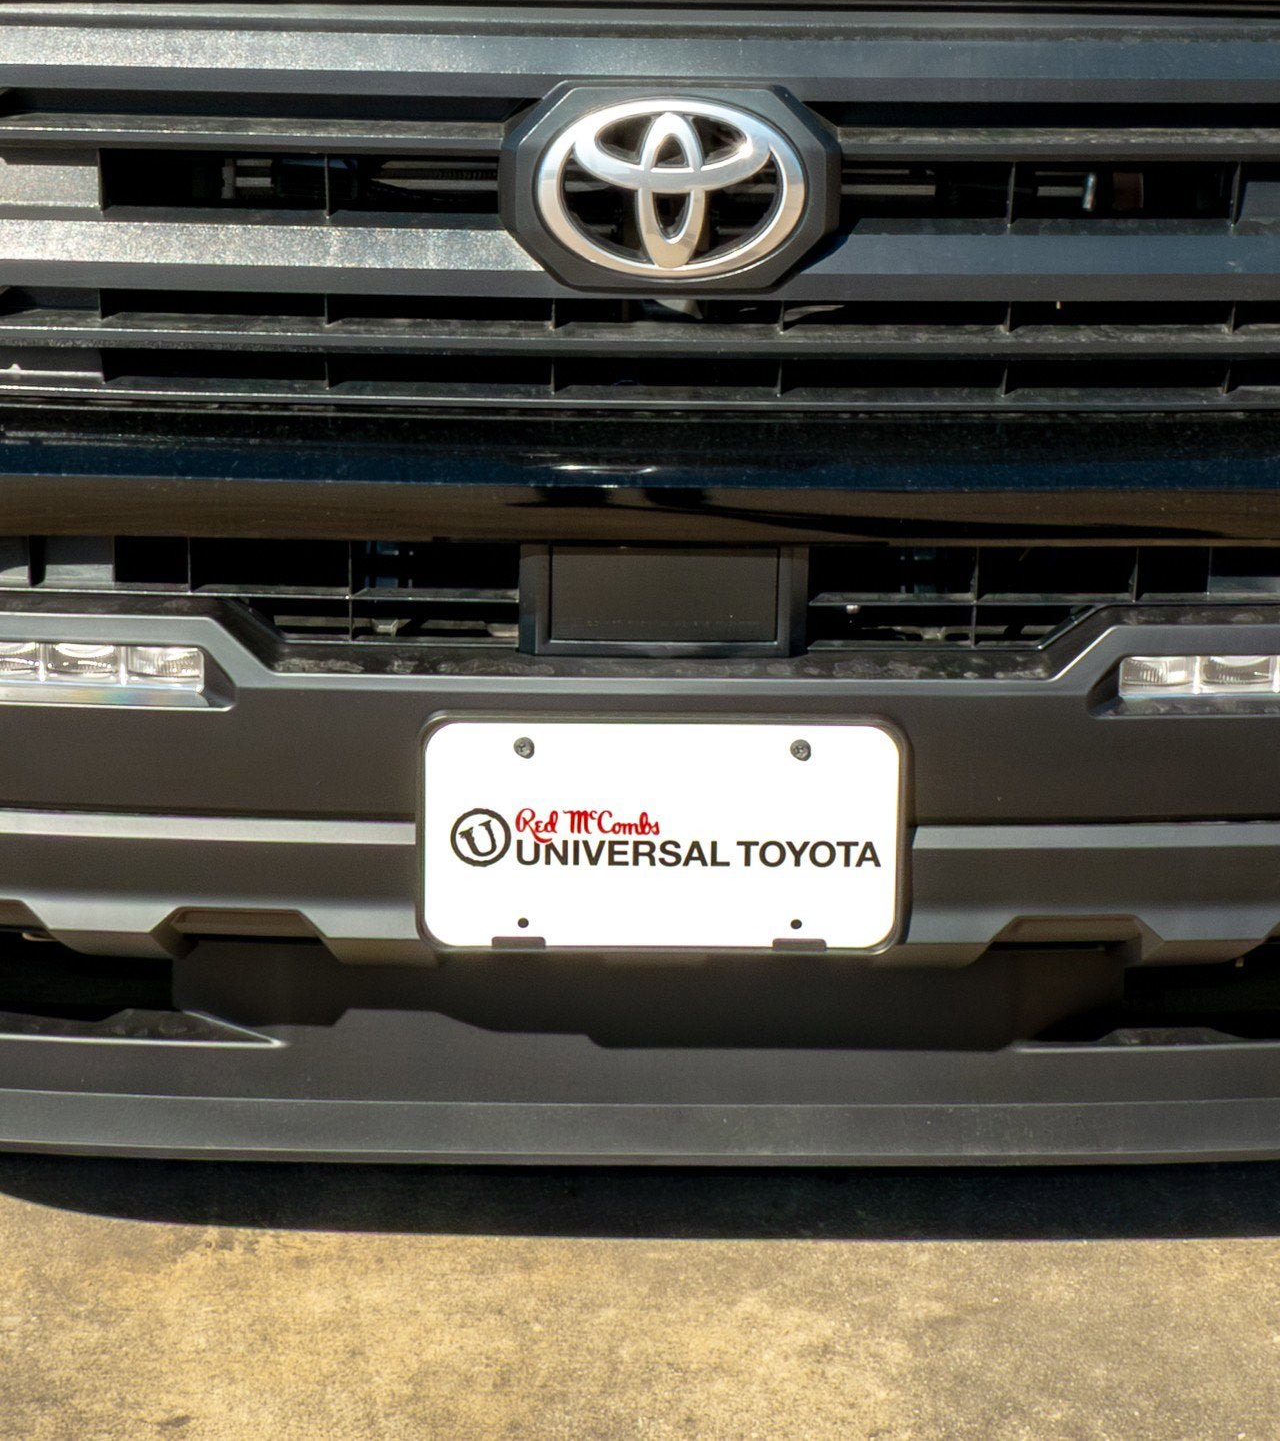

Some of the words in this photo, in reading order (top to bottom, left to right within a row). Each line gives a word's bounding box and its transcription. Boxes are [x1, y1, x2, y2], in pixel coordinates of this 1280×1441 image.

[515, 808, 559, 844] Red
[563, 809, 661, 837] McCombs
[516, 839, 731, 868] UNIVERSAL
[737, 840, 882, 868] TOYOTA
